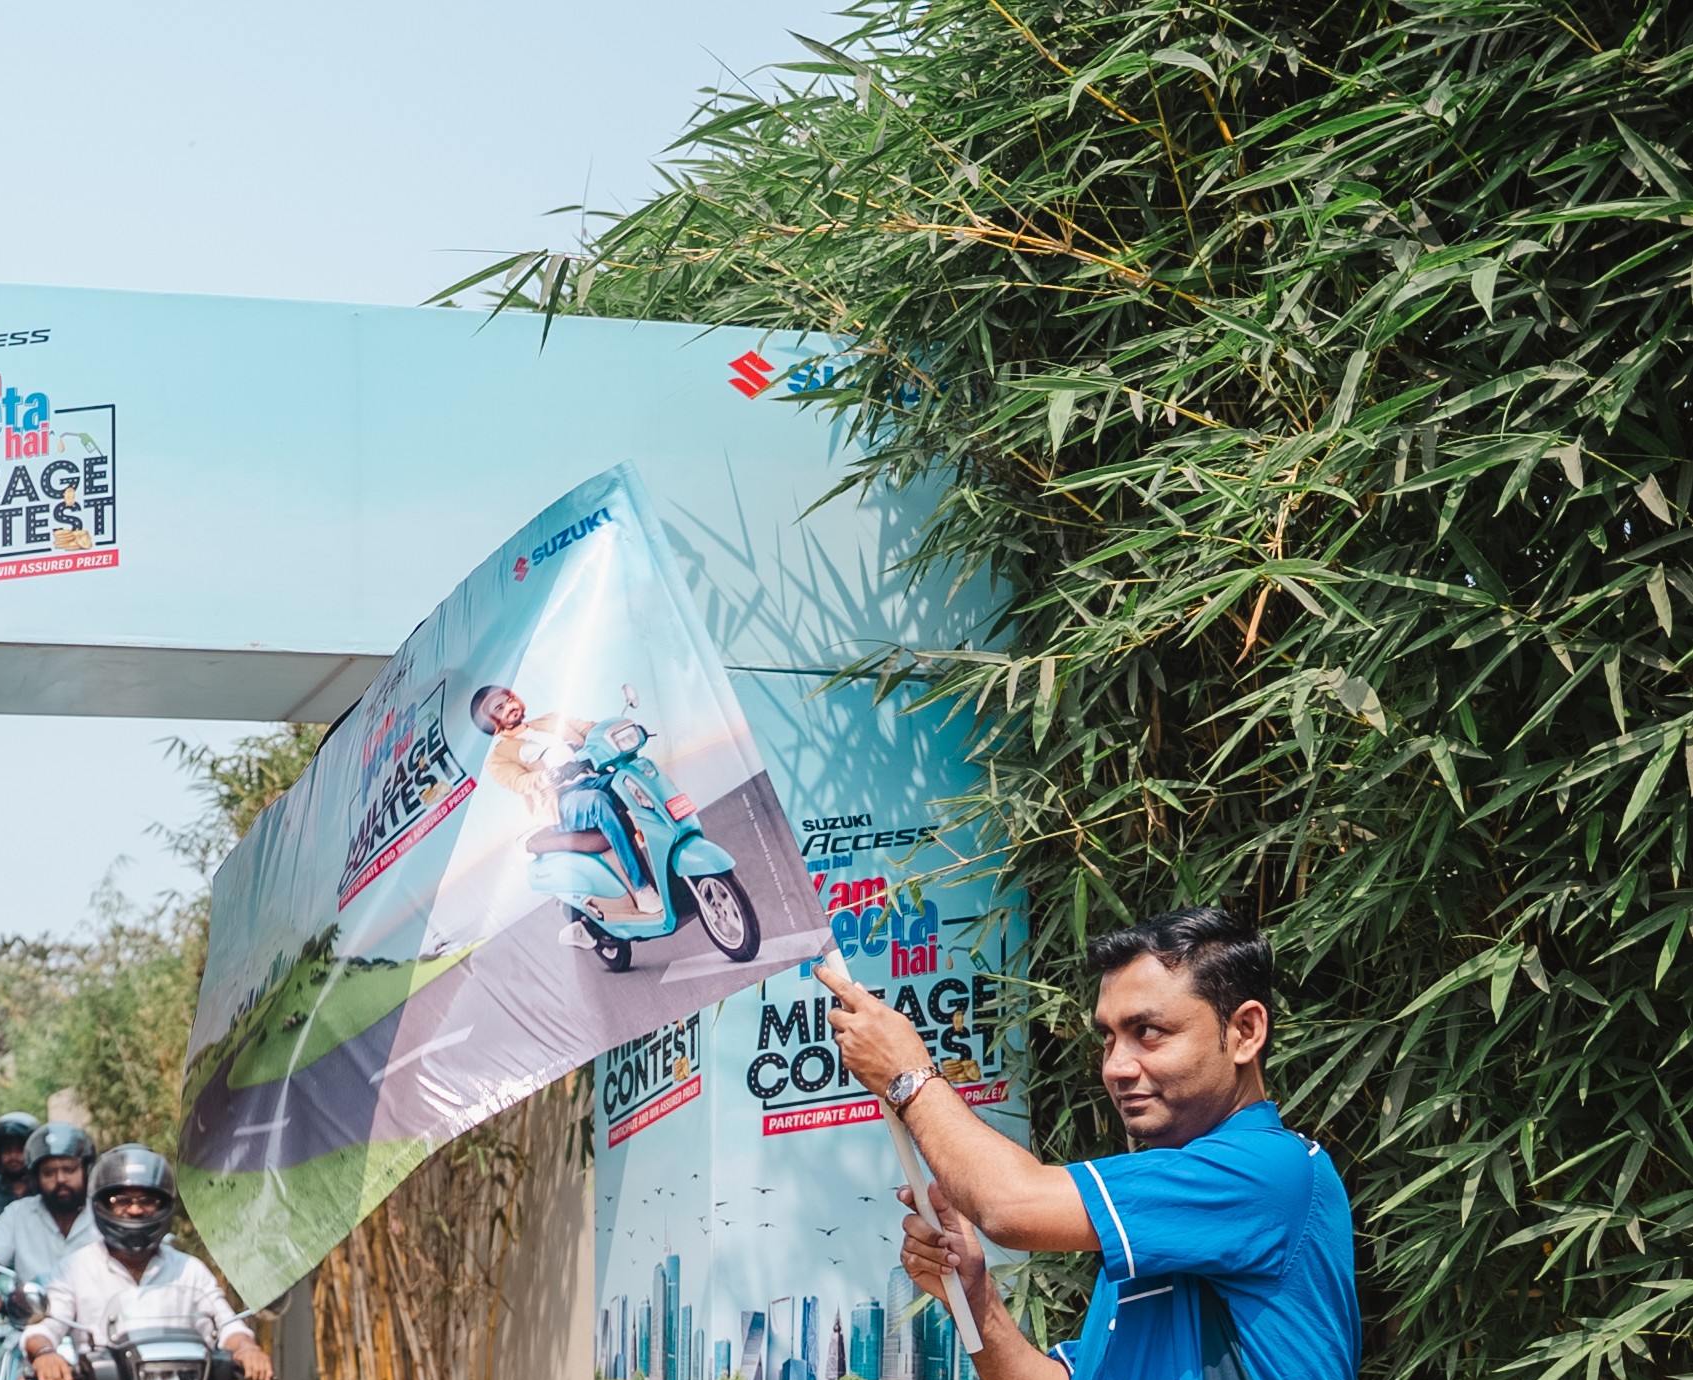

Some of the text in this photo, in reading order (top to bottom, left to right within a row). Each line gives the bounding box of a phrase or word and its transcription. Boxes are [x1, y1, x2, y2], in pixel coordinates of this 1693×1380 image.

[5, 422, 49, 460] hai
[531, 507, 613, 566] SUZUKI
[19, 558, 73, 575] ASSURED
[76, 554, 113, 569] PRIZE!
[801, 826, 939, 857] ACCESS
[802, 813, 872, 832] SUZUKI
[891, 935, 938, 980] hai
[757, 975, 998, 1050] MIAGE
[603, 1015, 700, 1116] CONTEST
[746, 1023, 996, 1099] COST
[769, 1111, 846, 1130] PARTICIPATE
[849, 1105, 875, 1119] AND
